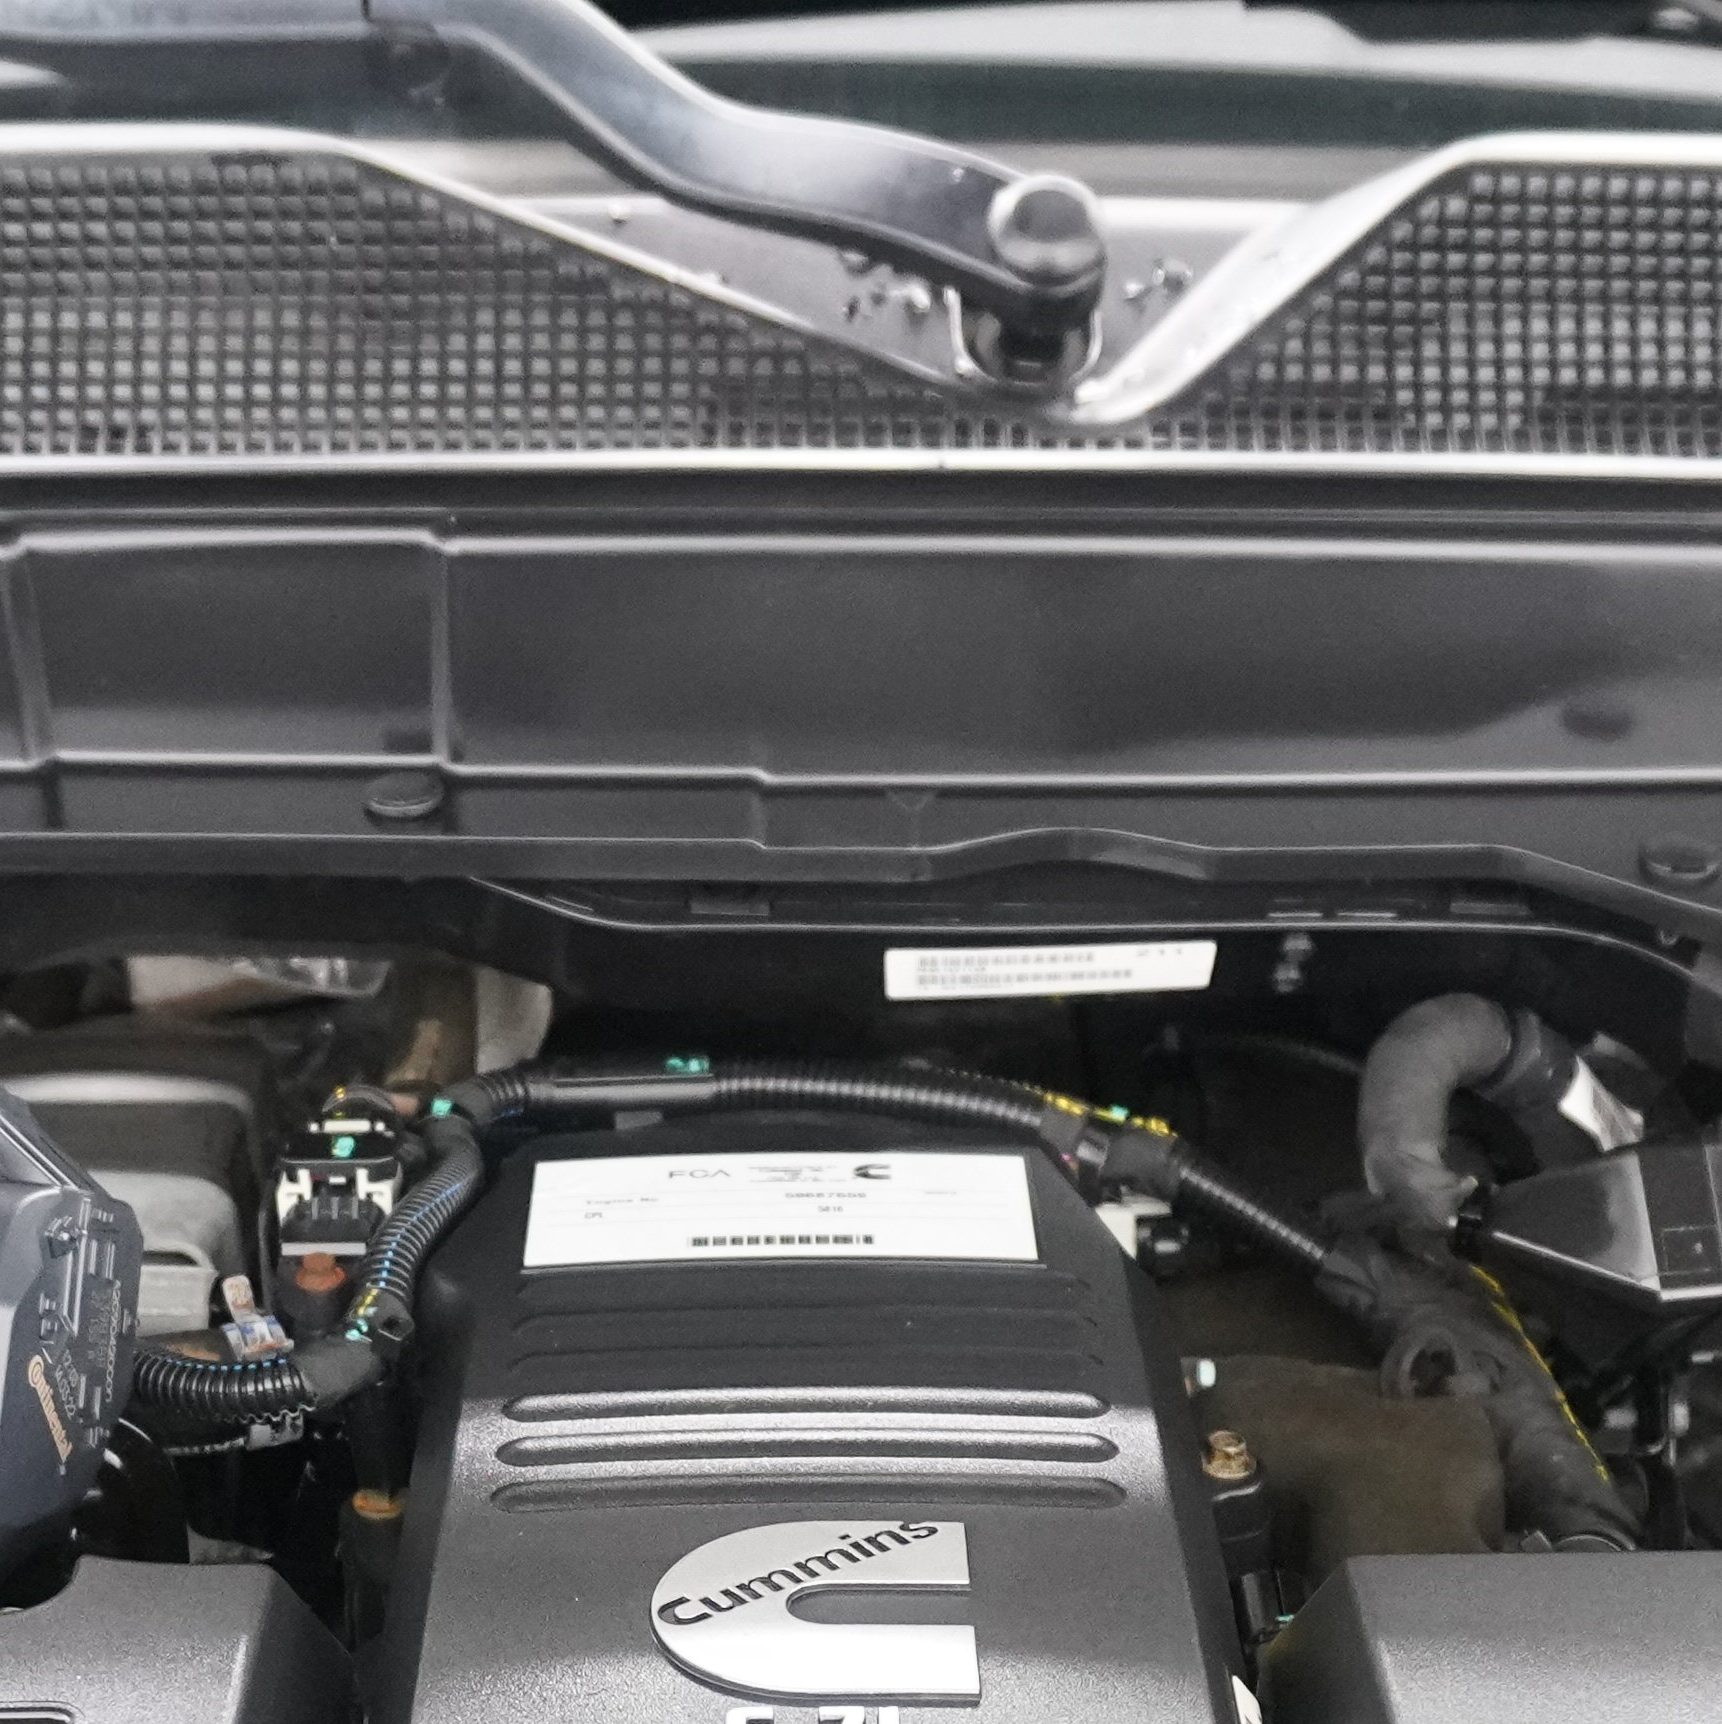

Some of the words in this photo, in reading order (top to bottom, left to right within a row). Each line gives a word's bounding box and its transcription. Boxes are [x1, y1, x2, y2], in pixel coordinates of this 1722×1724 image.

[668, 1168, 732, 1179] FCA
[28, 1354, 73, 1464] Continental
[657, 1521, 940, 1625] Cummins
